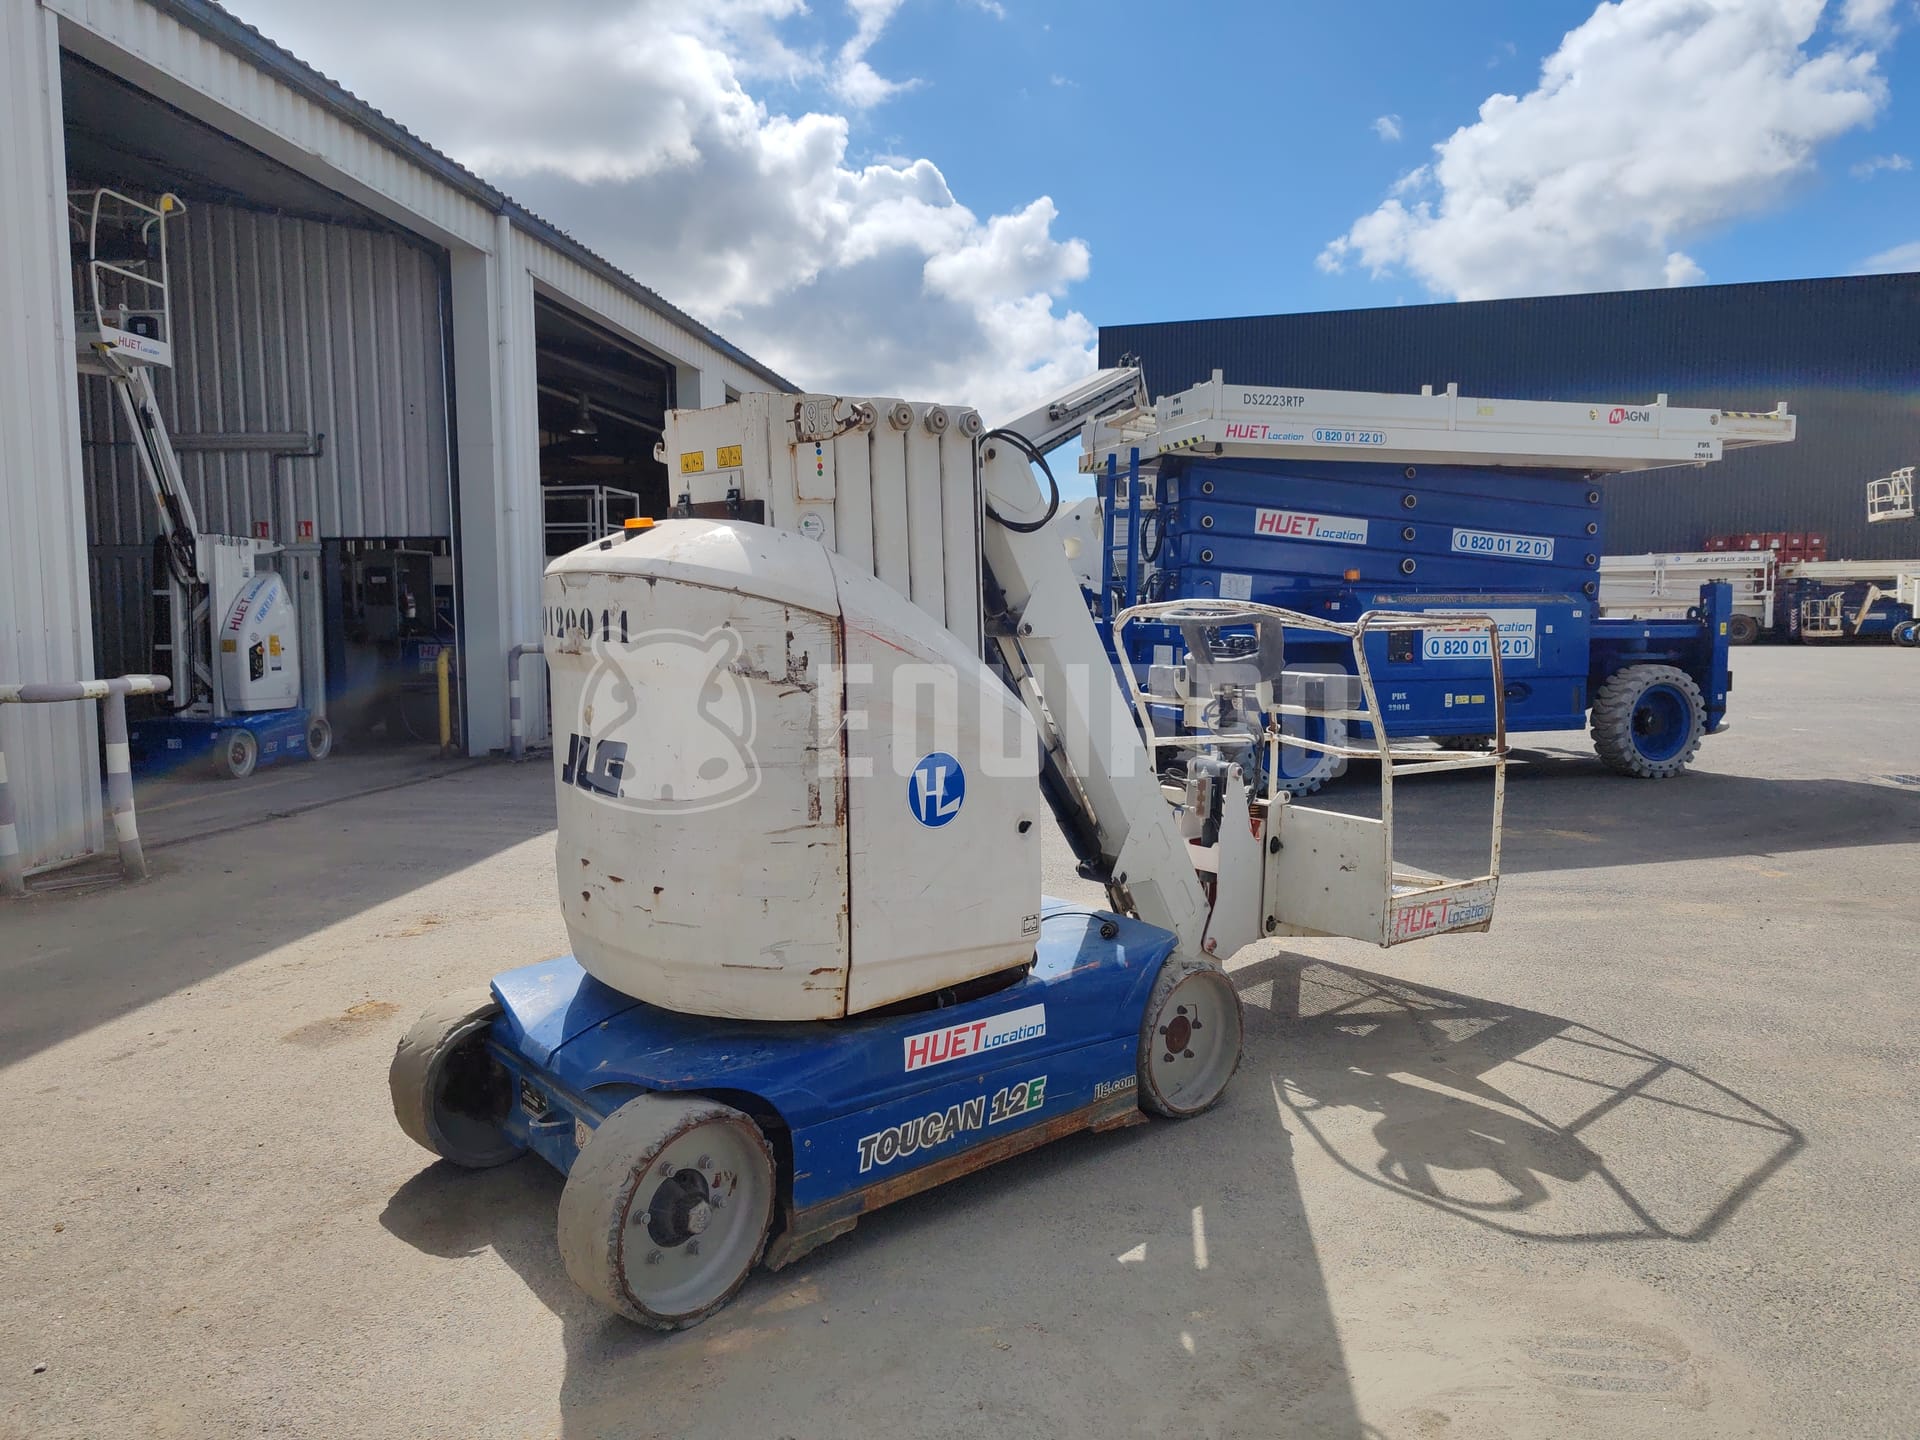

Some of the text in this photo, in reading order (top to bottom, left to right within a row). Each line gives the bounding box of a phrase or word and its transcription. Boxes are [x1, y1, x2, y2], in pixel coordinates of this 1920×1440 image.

[118, 336, 142, 350] HUET
[1243, 393, 1305, 407] DS2223RTP
[1610, 409, 1650, 423] MAGNI
[1225, 424, 1304, 441] HUET Location
[1316, 431, 1383, 443] 0 820 01 22 01
[1259, 513, 1364, 541] HUET Location
[1460, 534, 1548, 555] 0 820 01 22 01
[229, 598, 251, 631] HUET
[1431, 641, 1439, 654] 0
[1444, 640, 1468, 654] 820
[1473, 640, 1487, 654] 01
[1514, 640, 1528, 653] 01
[562, 733, 628, 798] JLG
[1395, 898, 1452, 937] HUET
[907, 1021, 1045, 1070] HUET Location
[1093, 1075, 1137, 1102] jlg.com
[858, 1075, 1047, 1174] TOUCAN 12E
